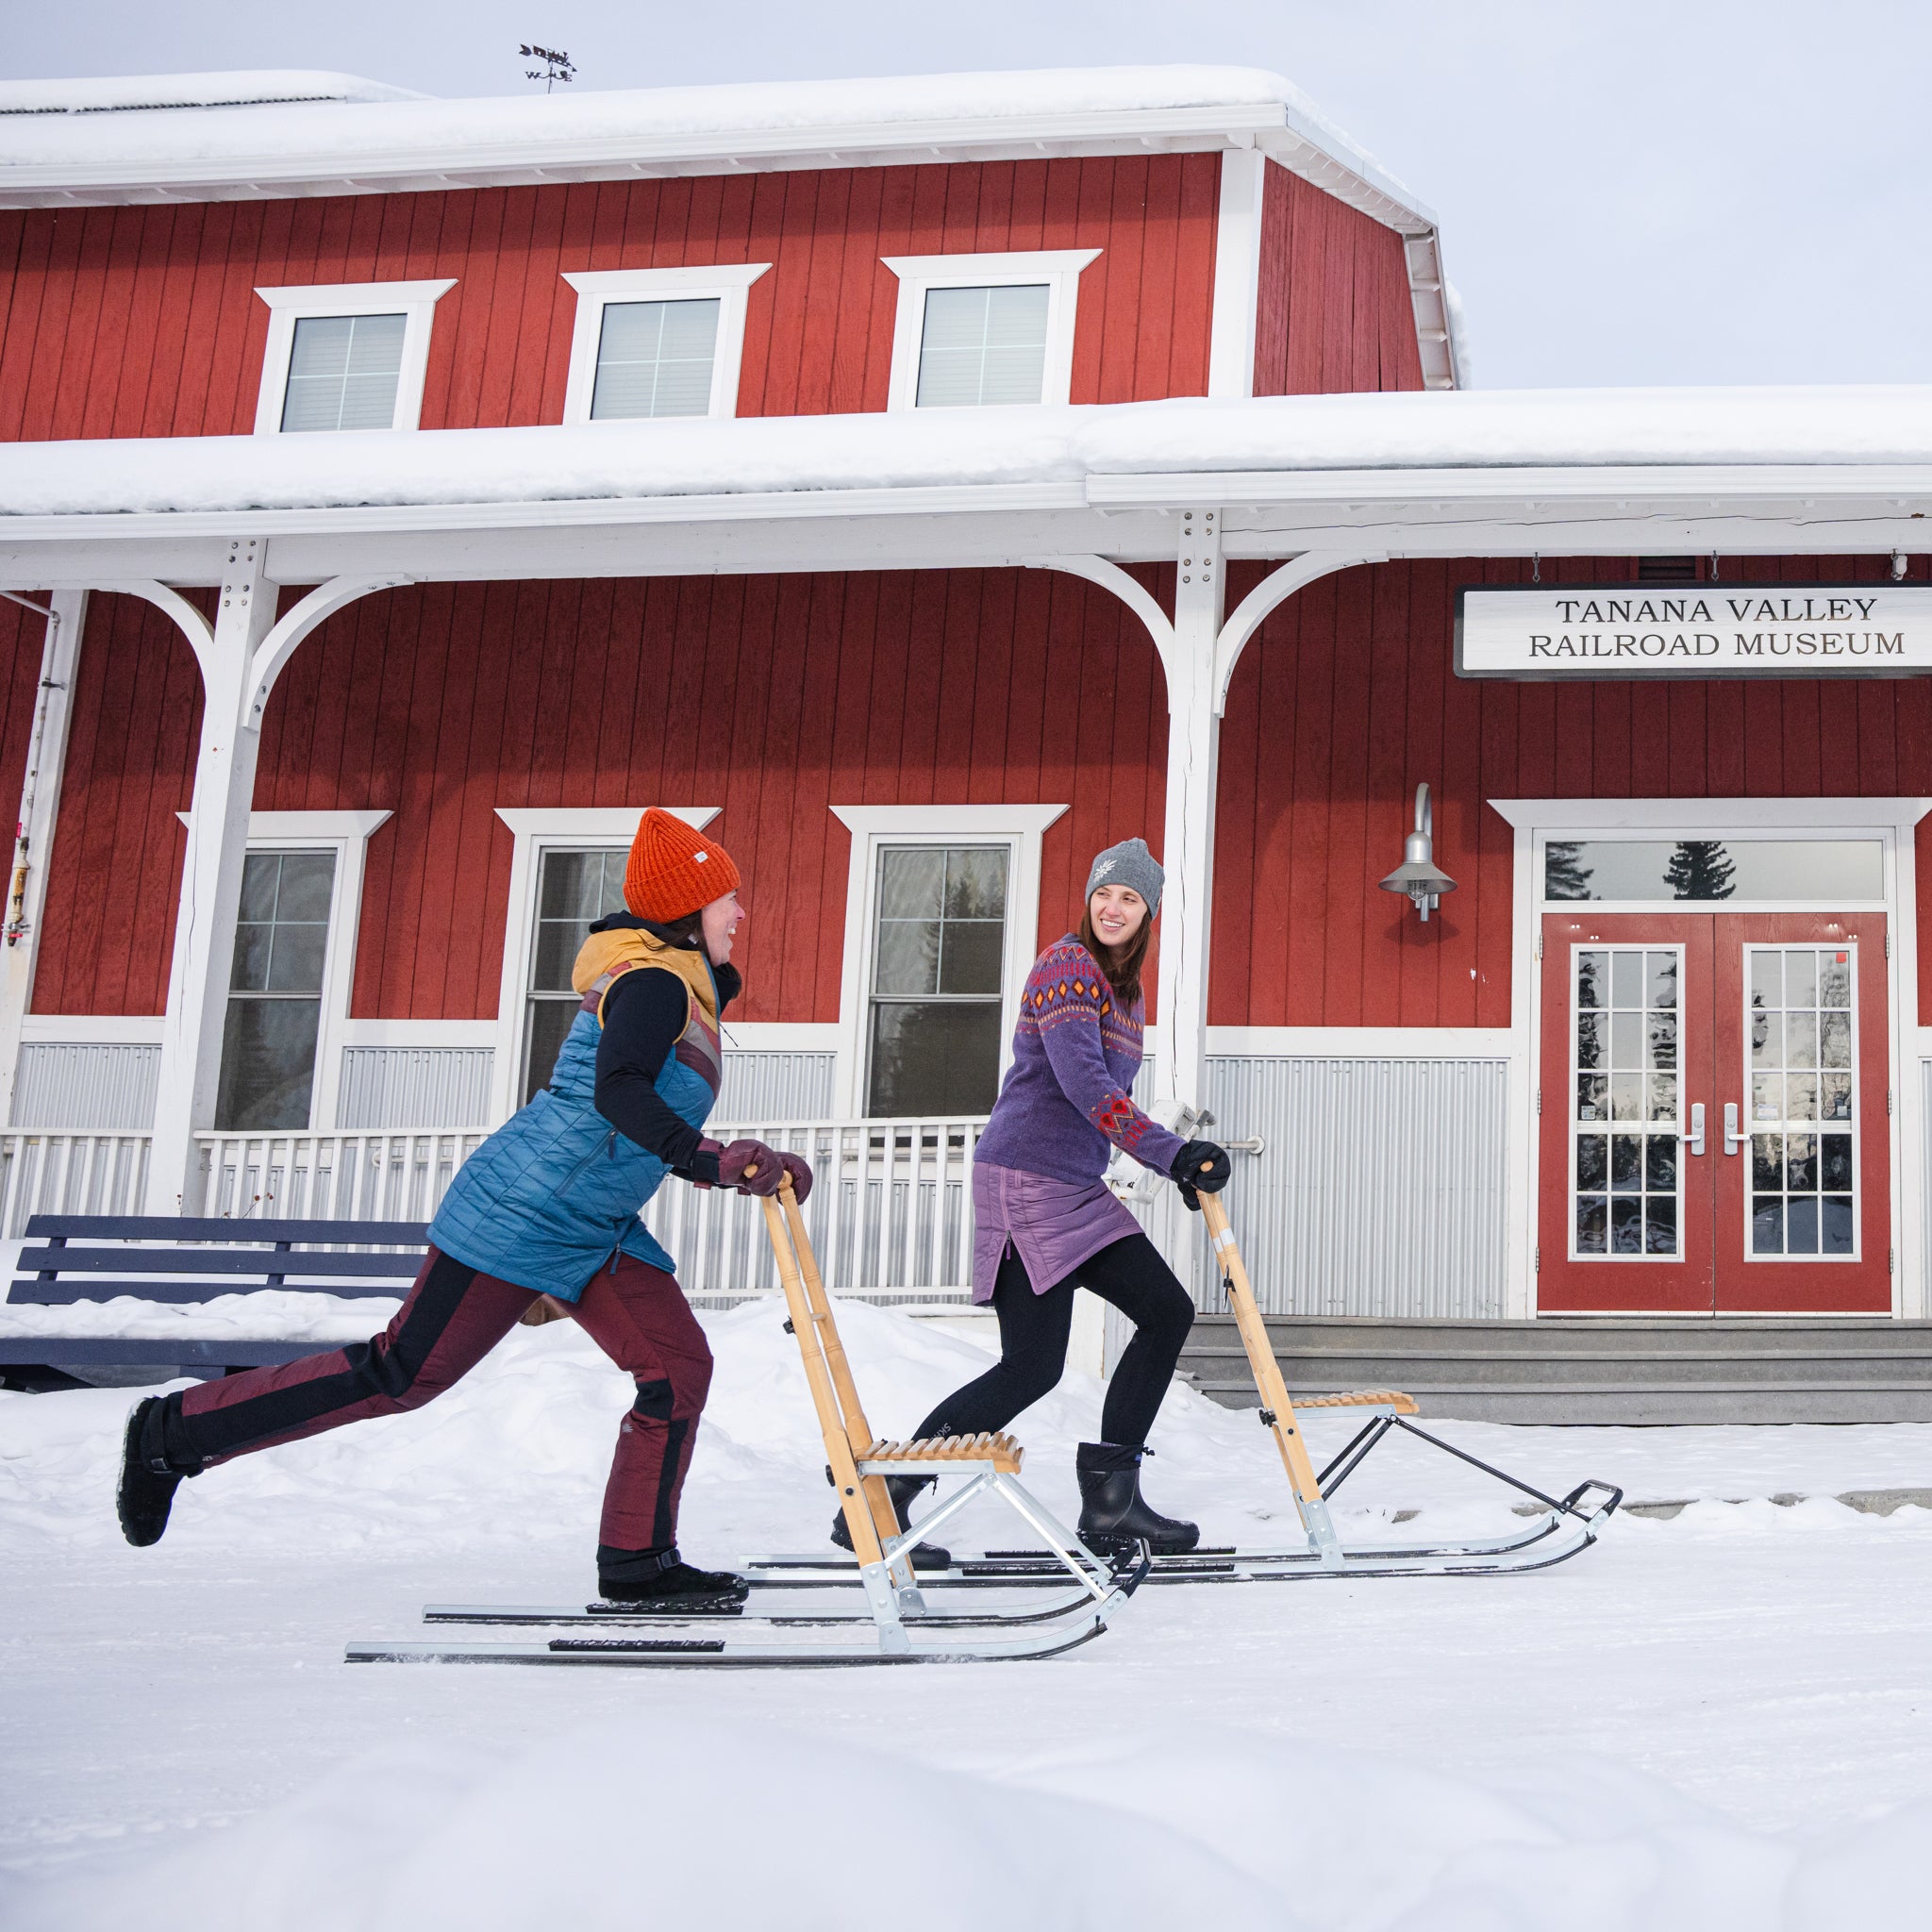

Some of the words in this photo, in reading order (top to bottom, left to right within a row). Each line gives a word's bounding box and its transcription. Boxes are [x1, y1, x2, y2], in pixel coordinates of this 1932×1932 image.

[1555, 599, 1715, 624] TANANA
[1725, 598, 1878, 622] VALLEY
[1528, 634, 1720, 658] RAILROAD
[1734, 632, 1905, 656] MUSEUM
